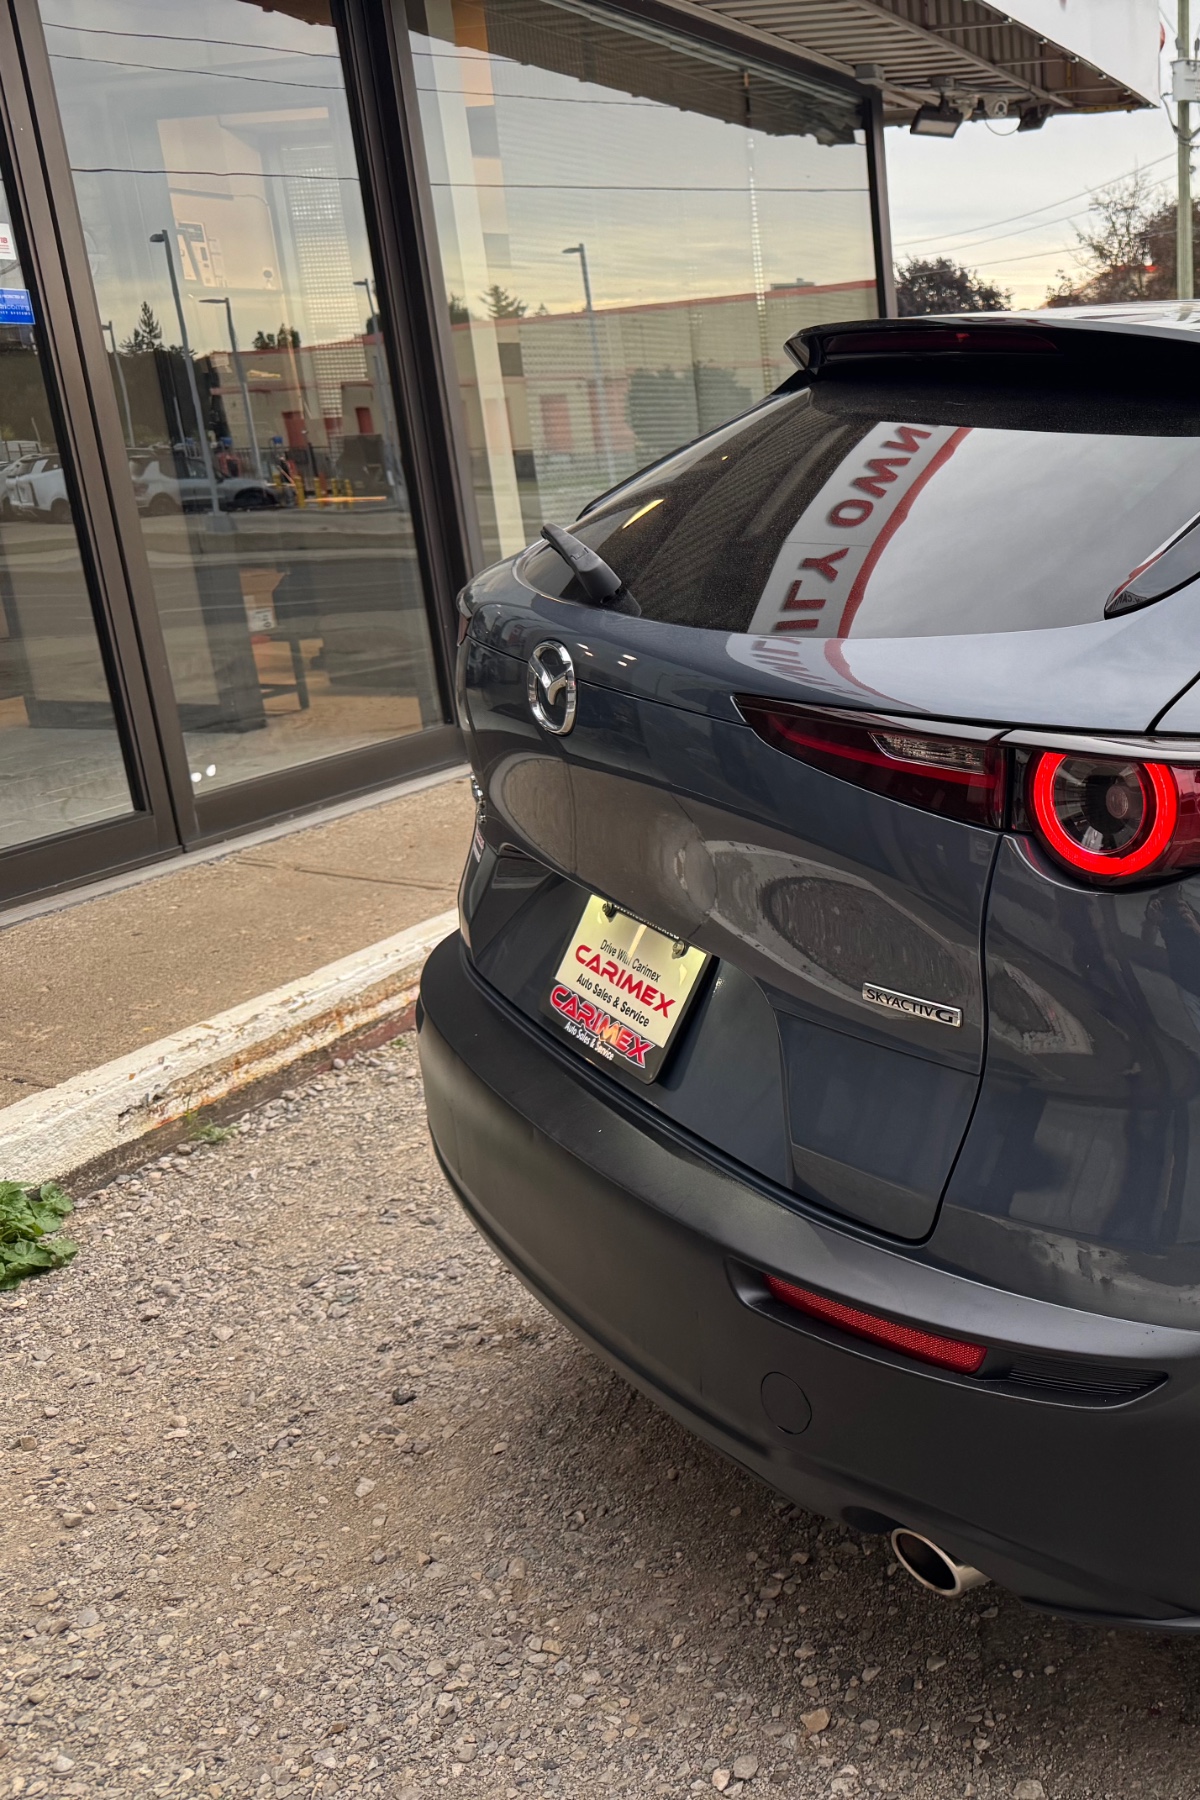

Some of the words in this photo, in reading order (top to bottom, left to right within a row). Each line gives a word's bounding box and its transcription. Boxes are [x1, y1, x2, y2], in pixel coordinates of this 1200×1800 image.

[575, 944, 676, 1019] CARIMEX
[600, 939, 617, 957] Drive
[632, 958, 661, 982] Carimex
[551, 985, 653, 1066] CARIMEX
[576, 973, 592, 991] Auto
[592, 984, 612, 1004] Sales
[612, 995, 620, 1009] &
[620, 1001, 650, 1027] Service
[564, 1021, 578, 1036] Auto
[575, 1029, 591, 1045] Sales
